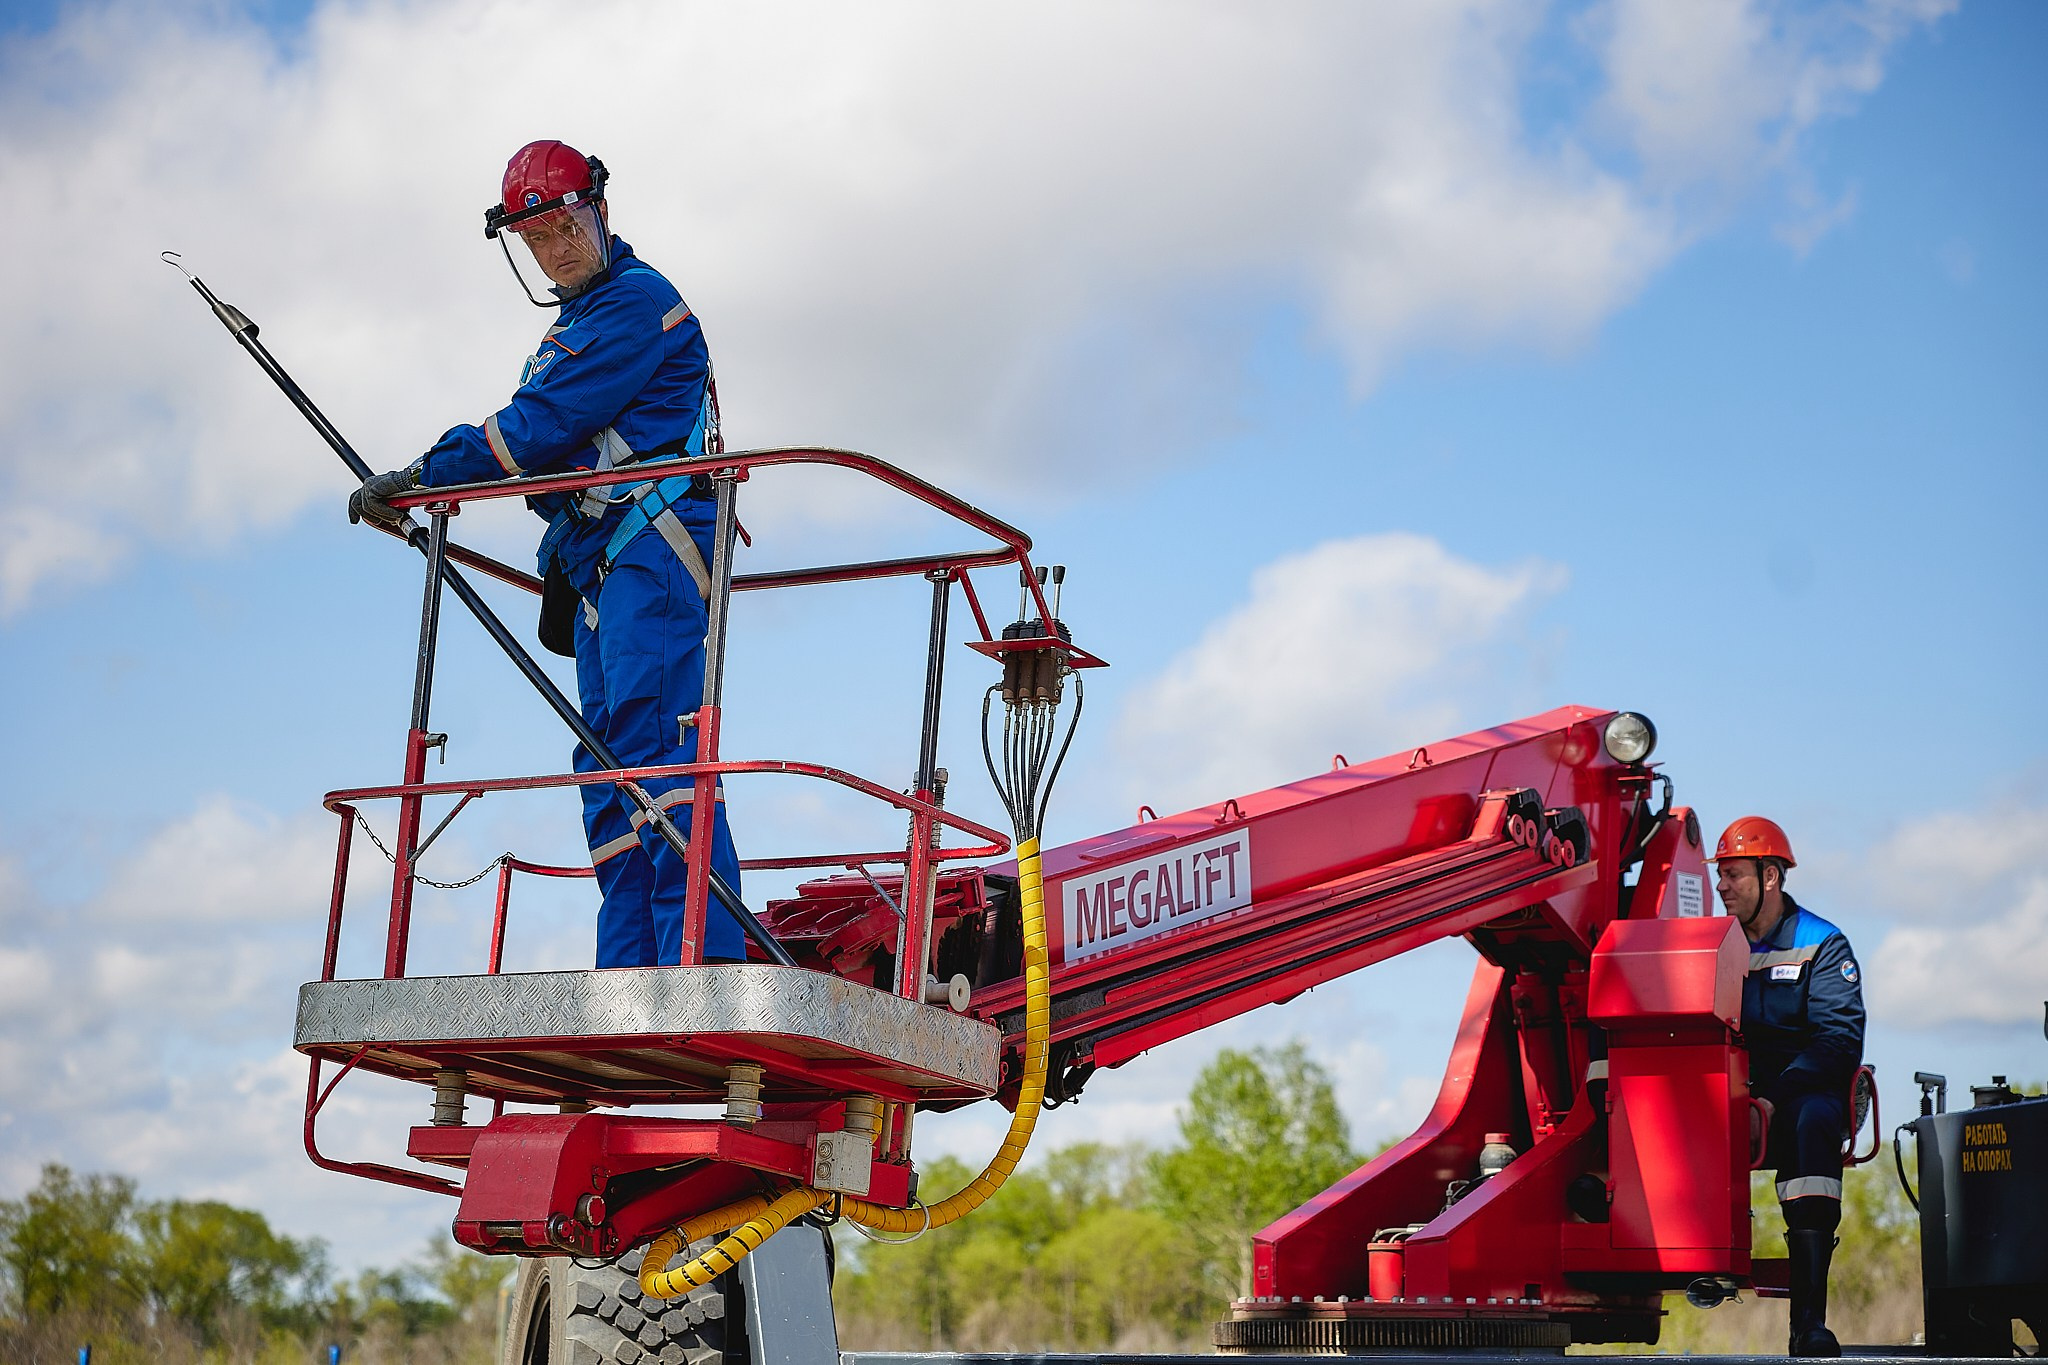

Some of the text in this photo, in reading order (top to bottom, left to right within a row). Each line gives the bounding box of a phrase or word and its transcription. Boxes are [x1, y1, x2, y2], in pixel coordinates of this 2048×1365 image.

[1076, 841, 1241, 949] MEGALIFT
[1965, 1123, 2007, 1146] РАБОТАТЬ
[1963, 1149, 2012, 1172] НА ОПОРАХ
